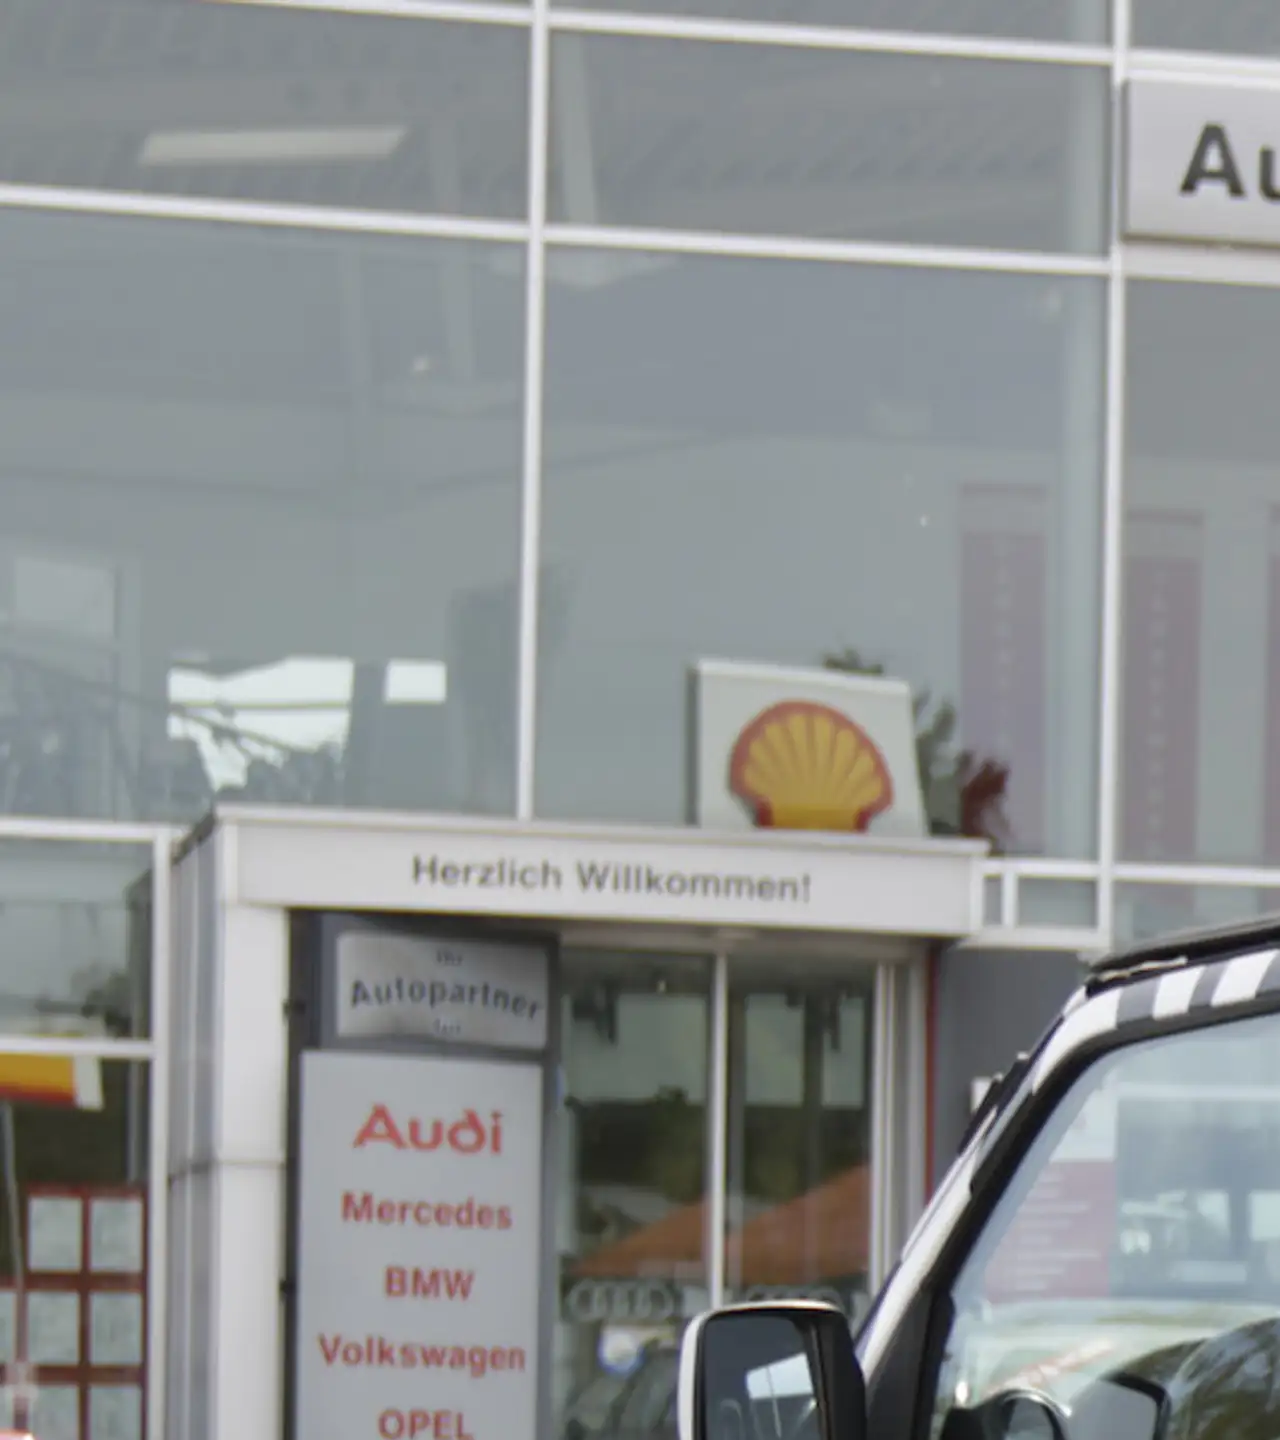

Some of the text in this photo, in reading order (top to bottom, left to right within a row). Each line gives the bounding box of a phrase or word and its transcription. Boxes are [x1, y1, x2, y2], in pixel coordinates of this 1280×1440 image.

[411, 853, 813, 904] Herzlich Willkommen!
[350, 976, 540, 1021] Autopartner
[353, 1104, 502, 1156] Audi
[341, 1191, 512, 1231] Mercedes
[384, 1265, 475, 1301] BMW
[317, 1333, 526, 1380] Volkswagen
